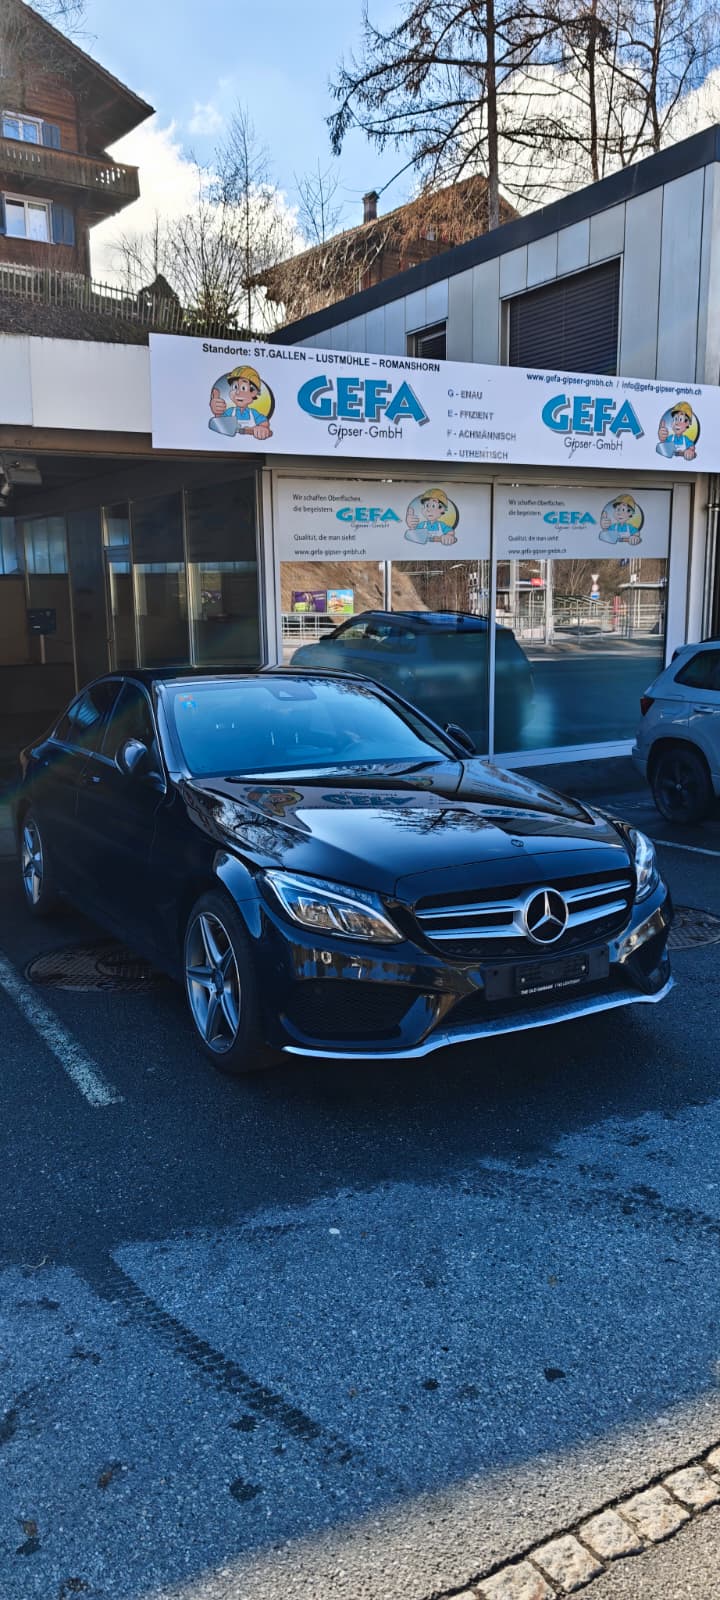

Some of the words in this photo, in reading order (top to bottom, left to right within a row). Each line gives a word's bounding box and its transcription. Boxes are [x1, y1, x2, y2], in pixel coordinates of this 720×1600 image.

[202, 343, 251, 357] Standorte:
[254, 348, 306, 361] ST.GALLEN
[316, 354, 370, 367] LUSTMÜHLE
[379, 360, 440, 373] ROMANSHORN
[526, 373, 613, 388] www.gefa-gipser-gmbh.ch
[621, 381, 702, 396] info@gefa-gipser-gmbh.ch
[297, 375, 430, 426] GEFA
[447, 389, 454, 397] G
[460, 390, 483, 400] ENAU
[447, 409, 453, 418] E
[541, 394, 644, 440] GEFA
[447, 429, 452, 437] F
[446, 449, 452, 457] A
[459, 450, 508, 460] UTHENTISCH
[336, 507, 402, 522] GEFA
[543, 511, 597, 525] GEFA
